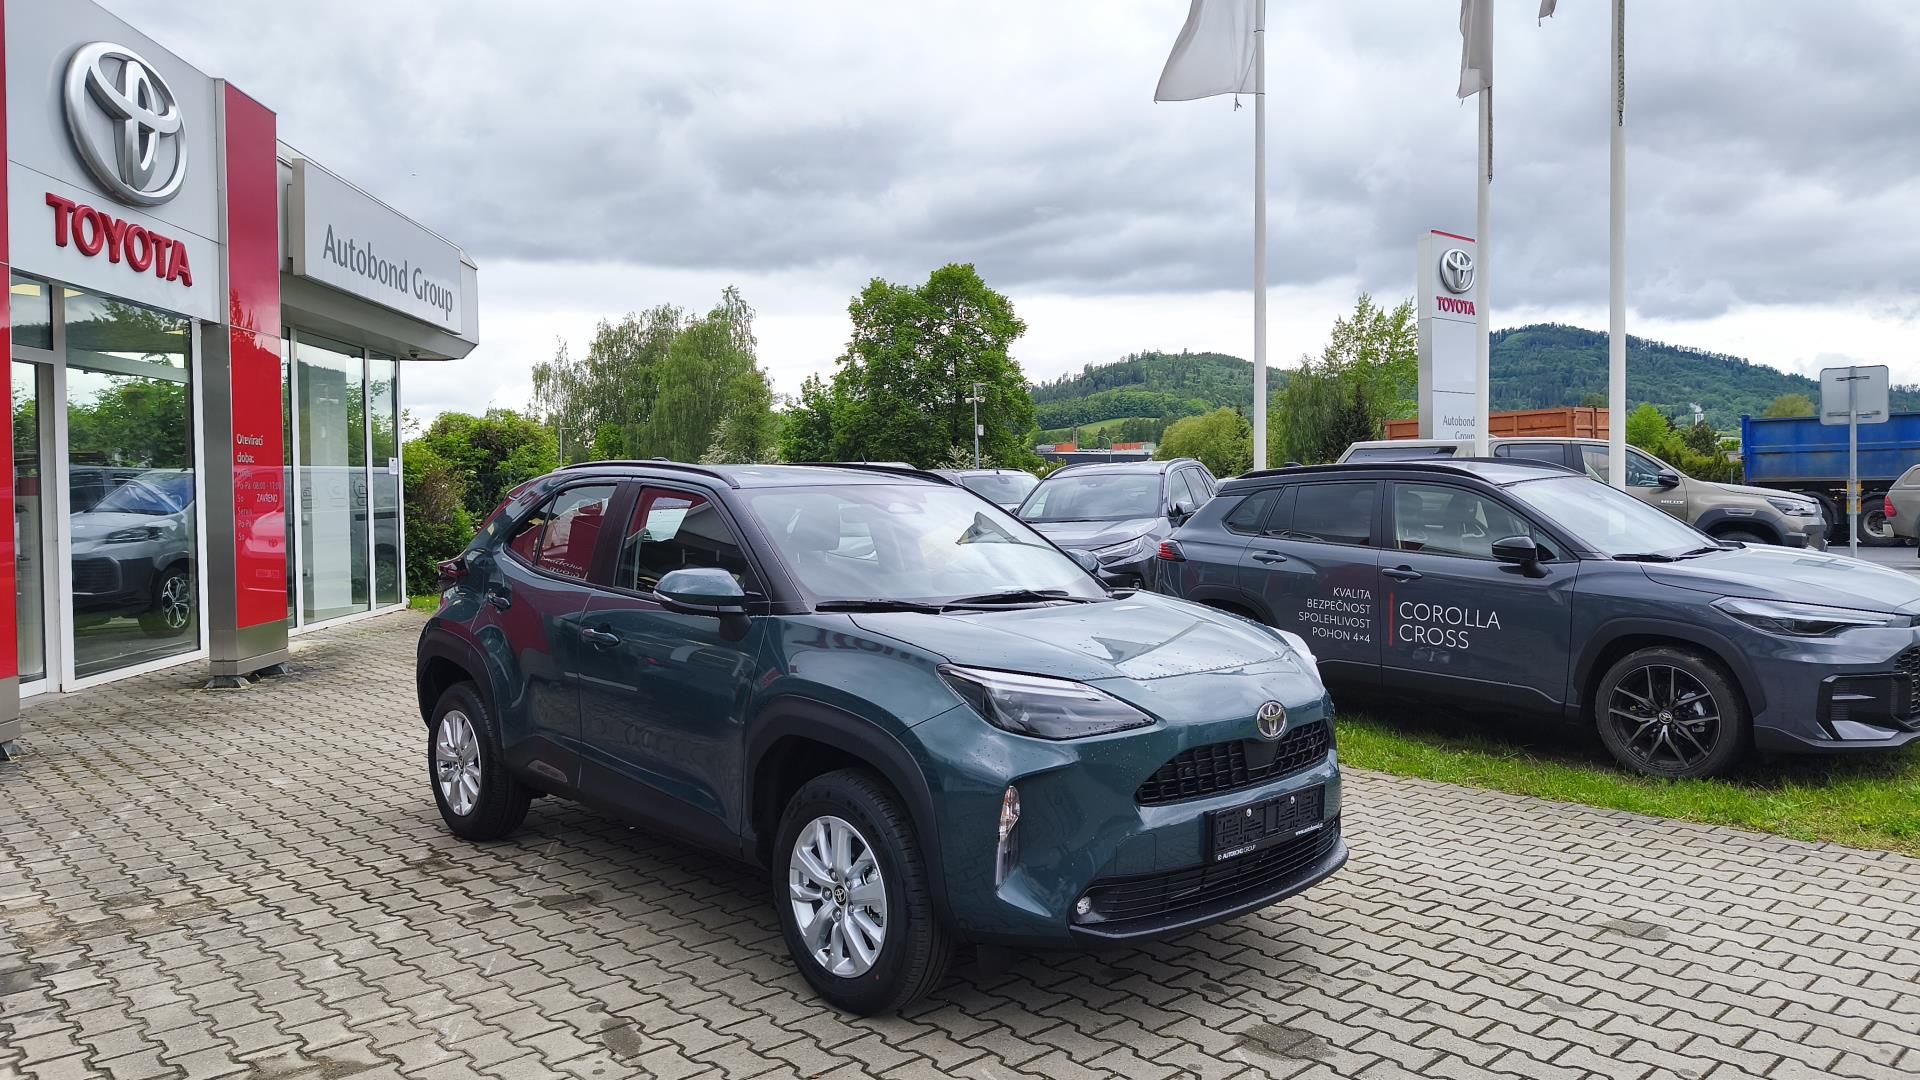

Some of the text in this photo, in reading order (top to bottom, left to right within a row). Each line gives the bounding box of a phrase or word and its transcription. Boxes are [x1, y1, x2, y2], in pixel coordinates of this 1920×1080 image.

[46, 192, 193, 288] TOYOTA
[322, 223, 454, 322] Autobond Group
[1436, 295, 1476, 316] TOYOTA
[1443, 415, 1475, 427] Autobond
[1333, 586, 1371, 600] KVALITA
[1307, 598, 1371, 615] BEZPEČNOST
[1399, 601, 1501, 630] COROLLA
[1298, 611, 1371, 629] SPOLEHLIVOST
[1312, 626, 1350, 641] POHON
[1399, 623, 1469, 649] CROSS
